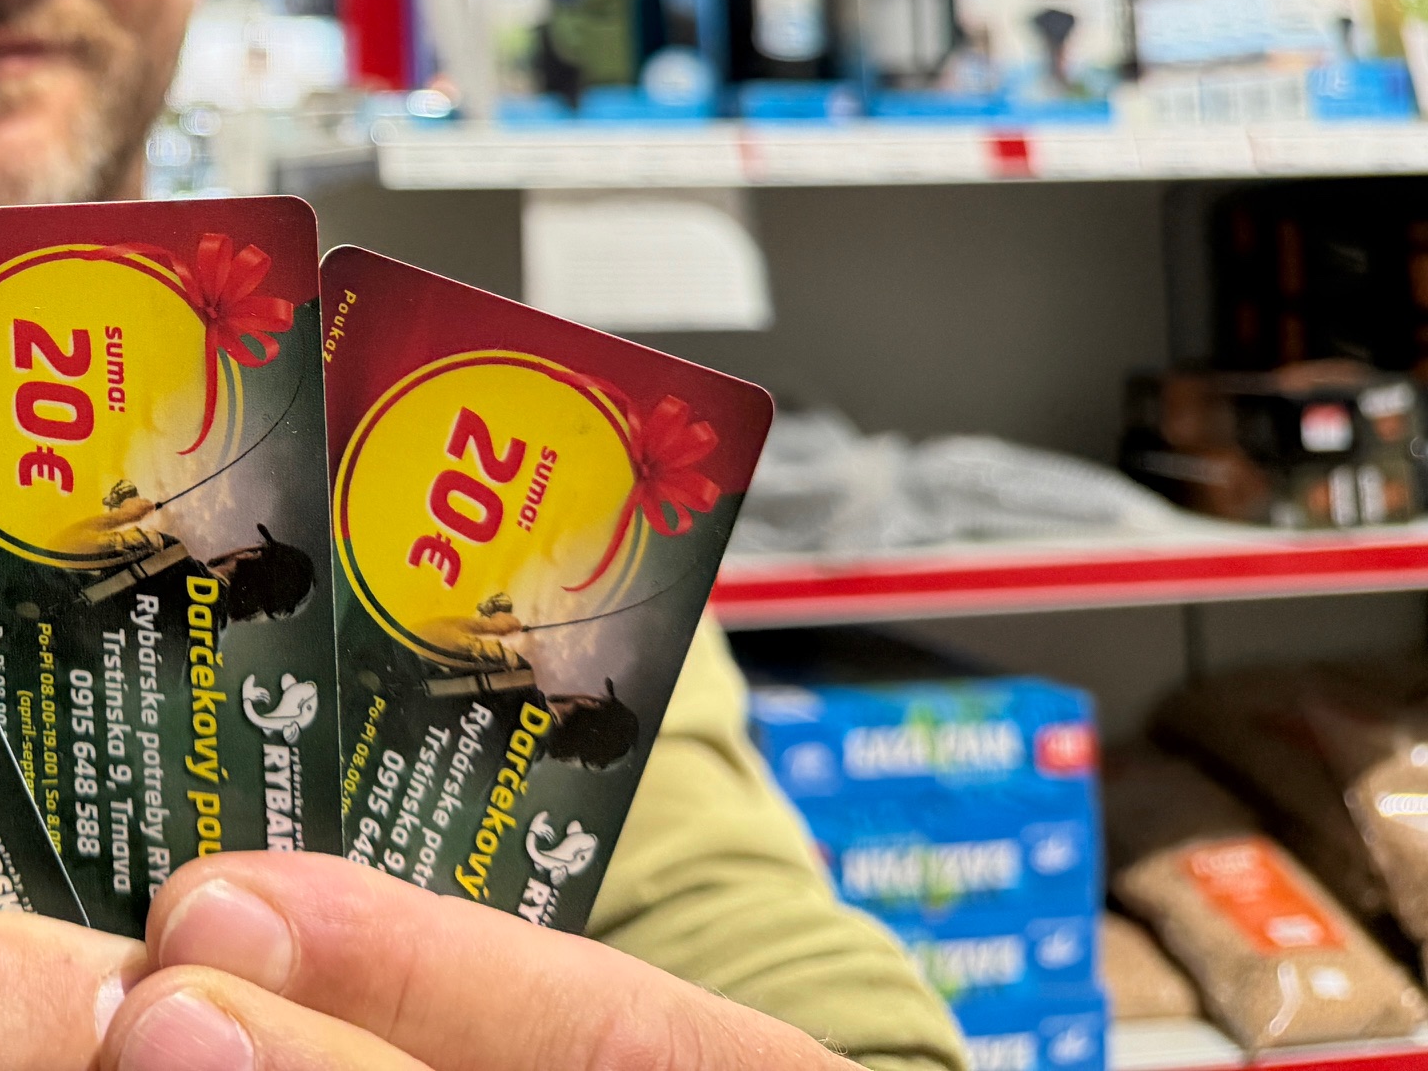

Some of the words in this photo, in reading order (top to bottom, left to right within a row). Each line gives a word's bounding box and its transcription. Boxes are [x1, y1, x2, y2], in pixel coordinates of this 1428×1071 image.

[105, 326, 125, 412] suma:
[322, 290, 356, 362] Poukaz
[14, 319, 94, 493] 20€
[409, 407, 527, 587] 20€
[517, 446, 557, 532] suma:
[38, 623, 54, 669] Po-Pi
[130, 594, 165, 725] Rybárske
[182, 573, 228, 783] Darčekový
[41, 673, 57, 775] 08.00-19.00
[70, 669, 94, 735] 0915
[103, 629, 131, 757] Trstínska
[361, 695, 386, 743] Po-Pi
[73, 742, 97, 795] 648
[106, 764, 132, 790] 9,
[136, 731, 169, 841] potreby
[368, 750, 405, 818] 0915
[391, 726, 449, 847] Trstínska
[432, 703, 492, 830] Rybárske
[448, 702, 558, 900] Darčekový
[76, 802, 100, 855] 588
[111, 798, 133, 892] Trnava
[345, 818, 381, 868] 648
[402, 827, 441, 891] potr
